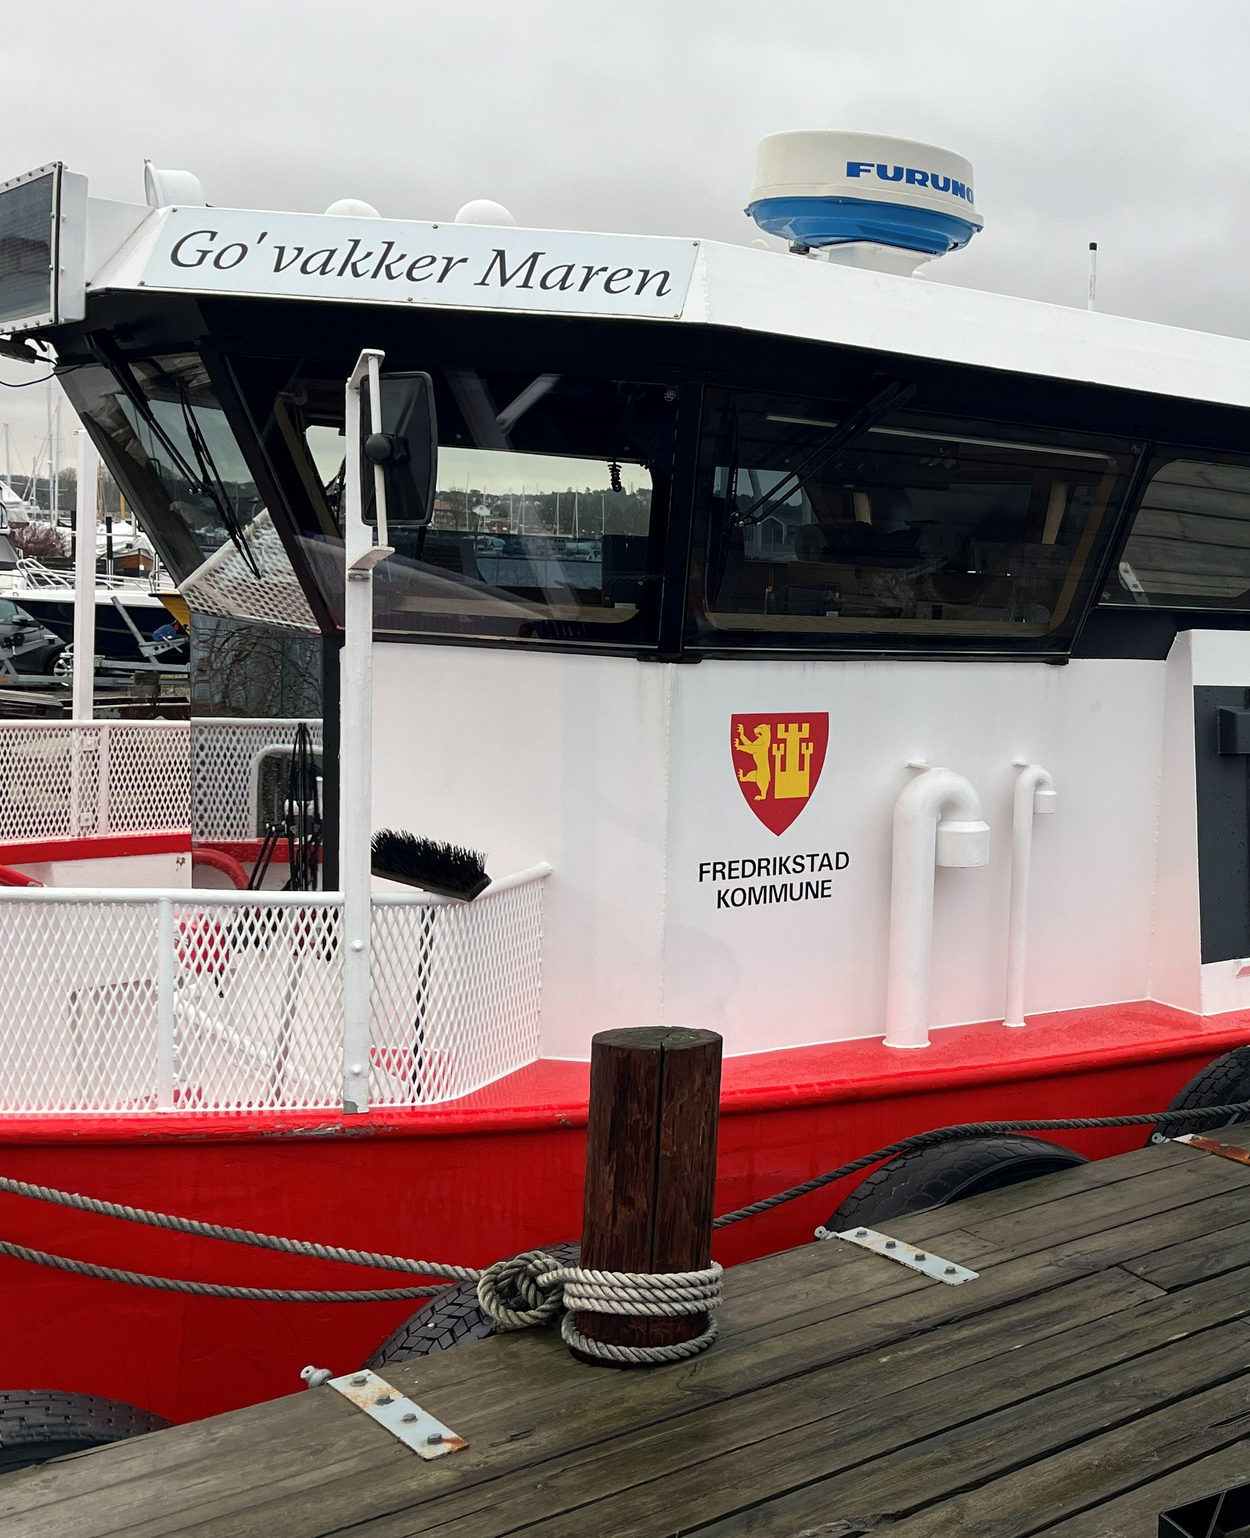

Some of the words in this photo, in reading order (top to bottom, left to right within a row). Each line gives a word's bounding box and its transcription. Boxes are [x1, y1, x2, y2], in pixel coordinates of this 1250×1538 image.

[473, 248, 673, 298] Maren
[698, 851, 850, 883] FREDRIKSTAD
[716, 879, 833, 909] KOMMUNE
